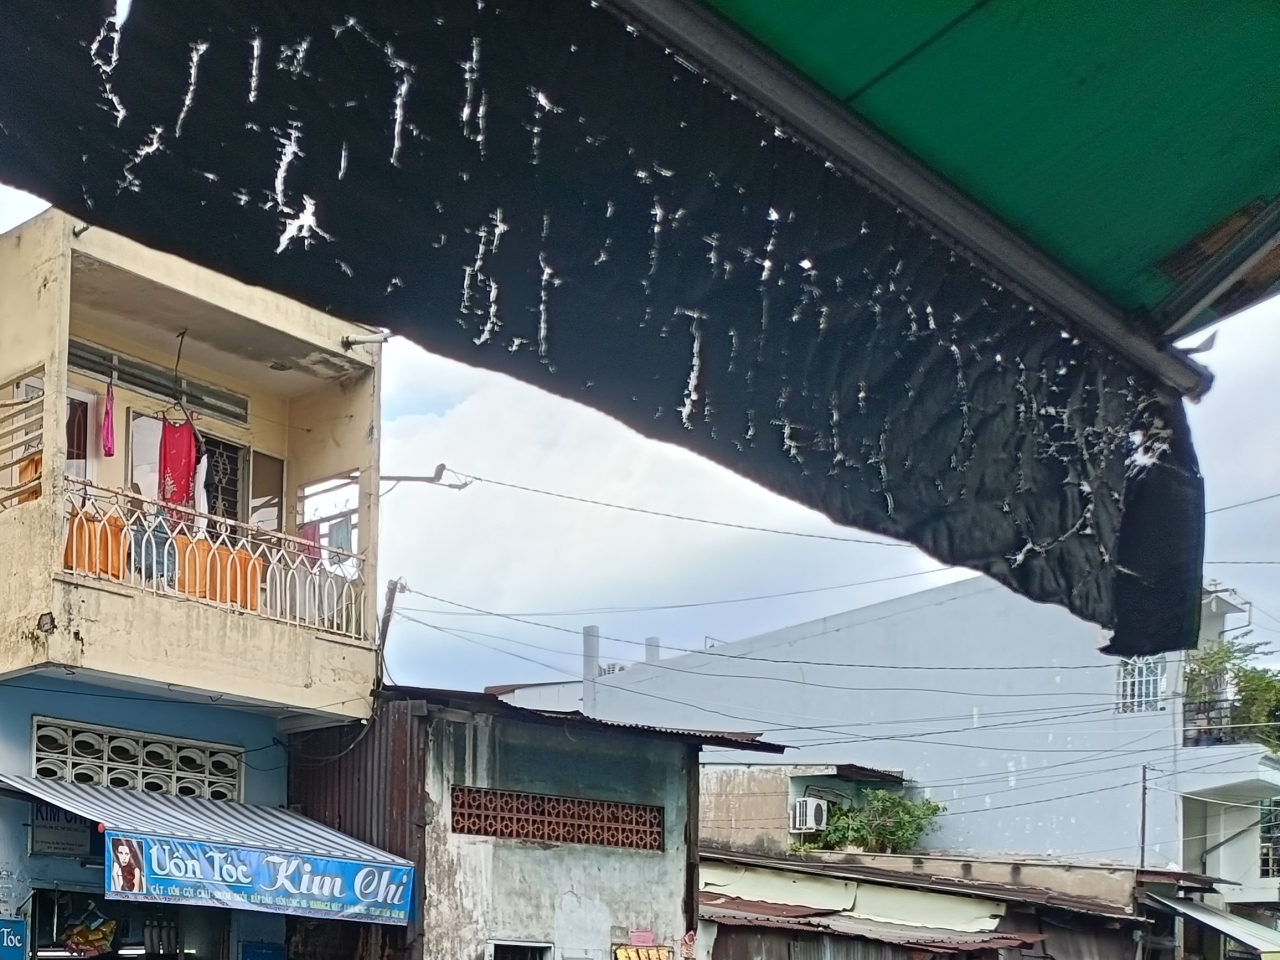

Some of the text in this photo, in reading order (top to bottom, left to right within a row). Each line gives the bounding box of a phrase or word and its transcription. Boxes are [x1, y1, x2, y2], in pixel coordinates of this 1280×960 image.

[150, 845, 408, 905] Uốn Tóc Kim Chi
[0, 927, 22, 947] Tóc
